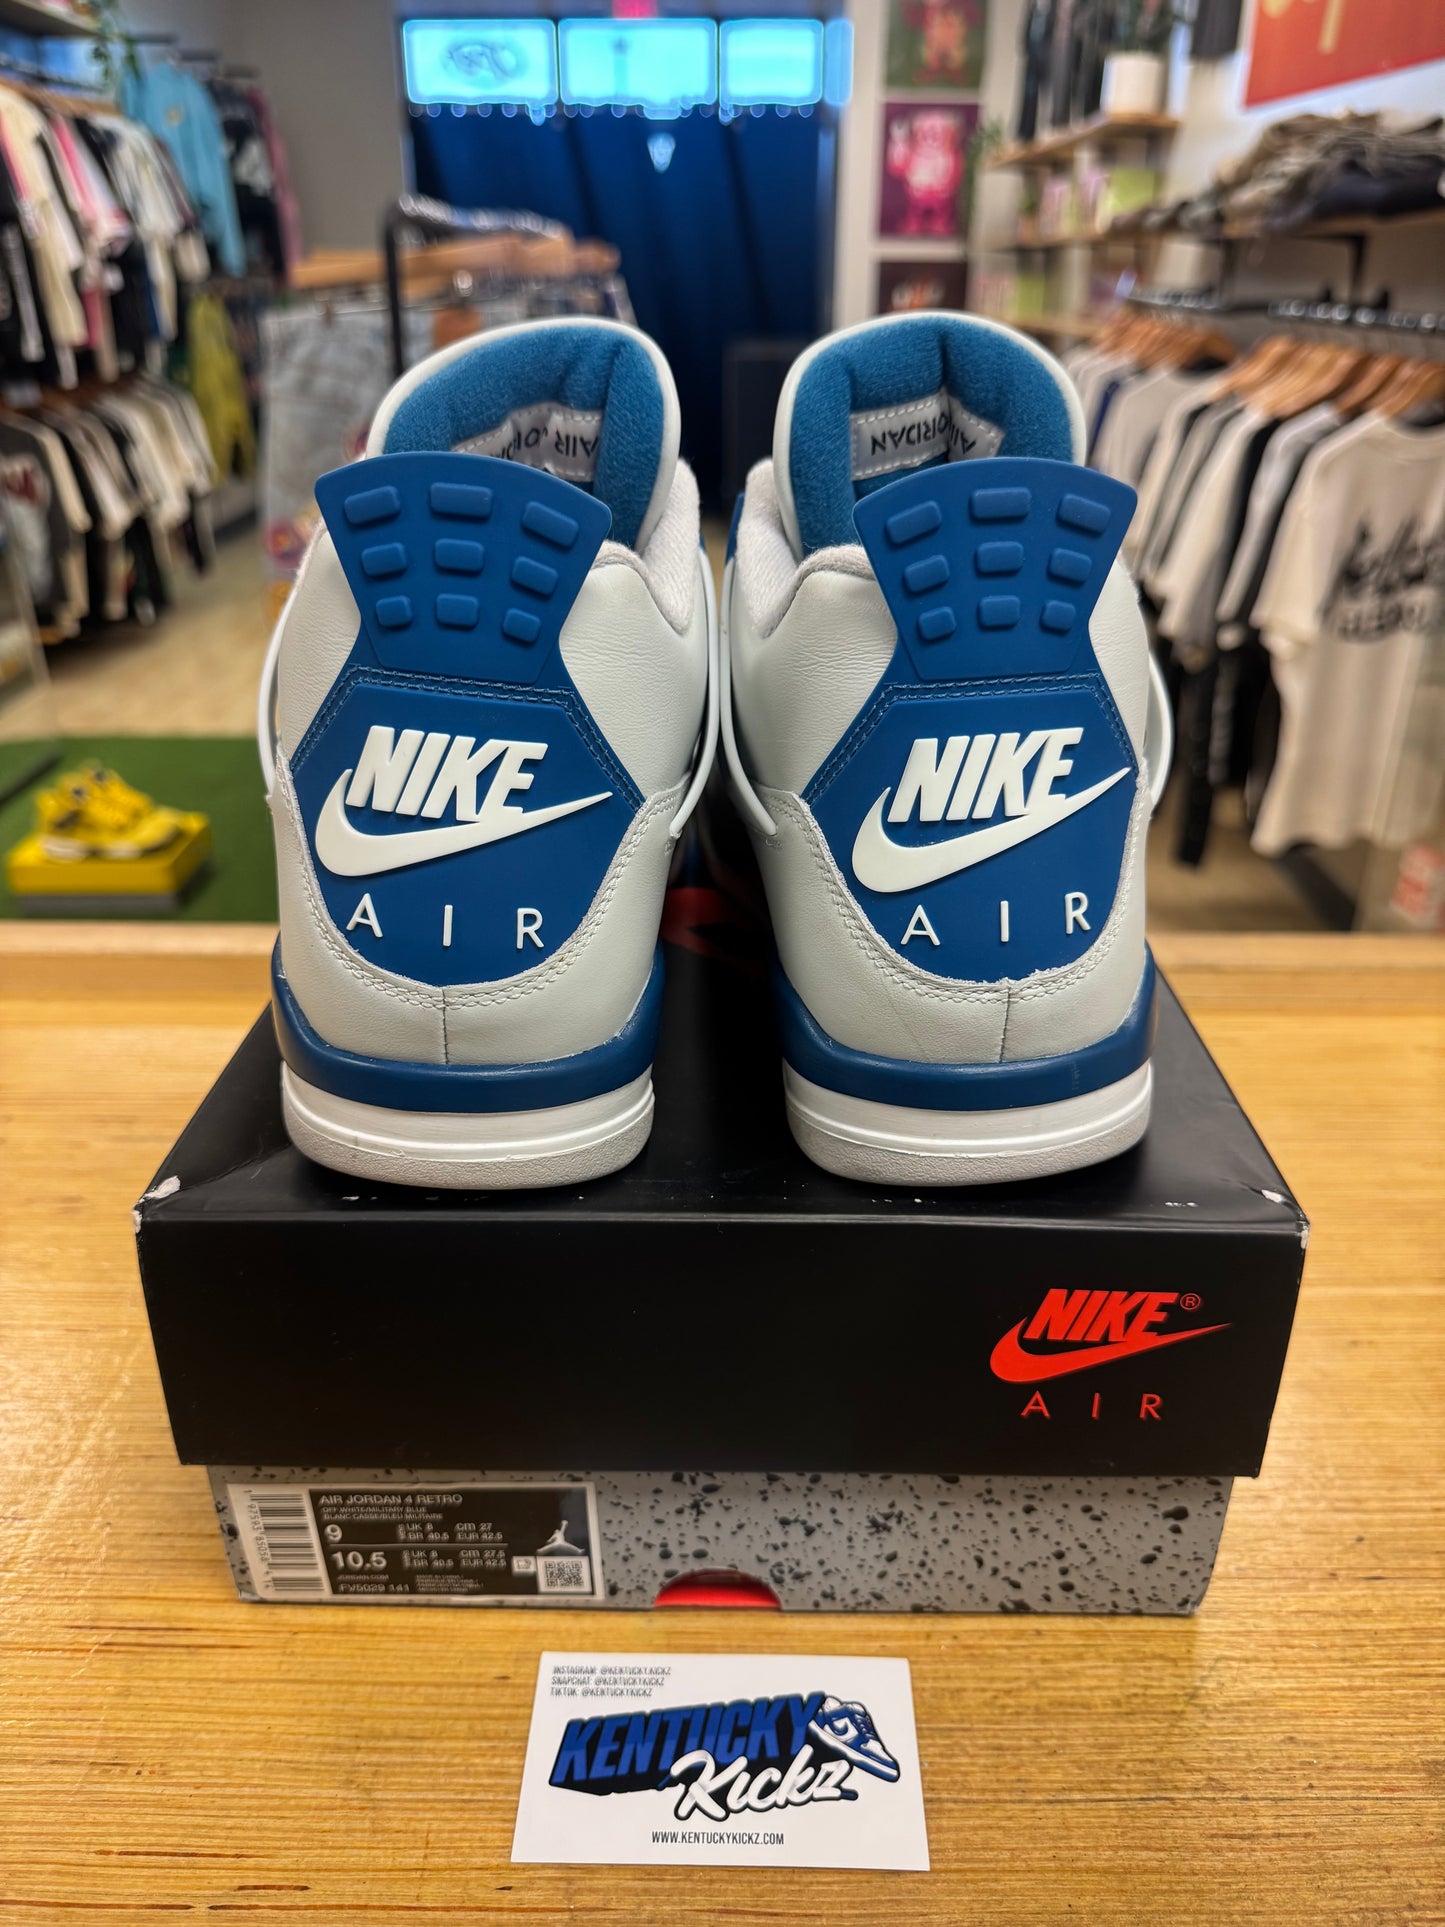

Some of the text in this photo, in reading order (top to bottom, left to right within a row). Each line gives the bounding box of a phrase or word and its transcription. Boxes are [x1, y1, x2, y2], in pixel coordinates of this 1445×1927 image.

[345, 725, 548, 822] NIKE
[887, 727, 1084, 822] NIKE
[346, 892, 545, 950] AIR
[901, 891, 1091, 946] AIR
[1020, 1390, 1162, 1420] AIR
[320, 1494, 463, 1504] AIR JORDAN 4 RETRO
[324, 1524, 342, 1541] 9
[406, 1522, 422, 1530] UK
[480, 1522, 492, 1530] 27
[428, 1532, 450, 1540] 40.5
[458, 1532, 479, 1540] EUR
[480, 1532, 503, 1540] 42.5
[332, 1551, 387, 1569] 10.5
[552, 1692, 825, 1785] KENTUCKY
[671, 1744, 853, 1820] Kickz
[652, 1831, 784, 1845] WWW.KENTUCKYKICKZ.COM
